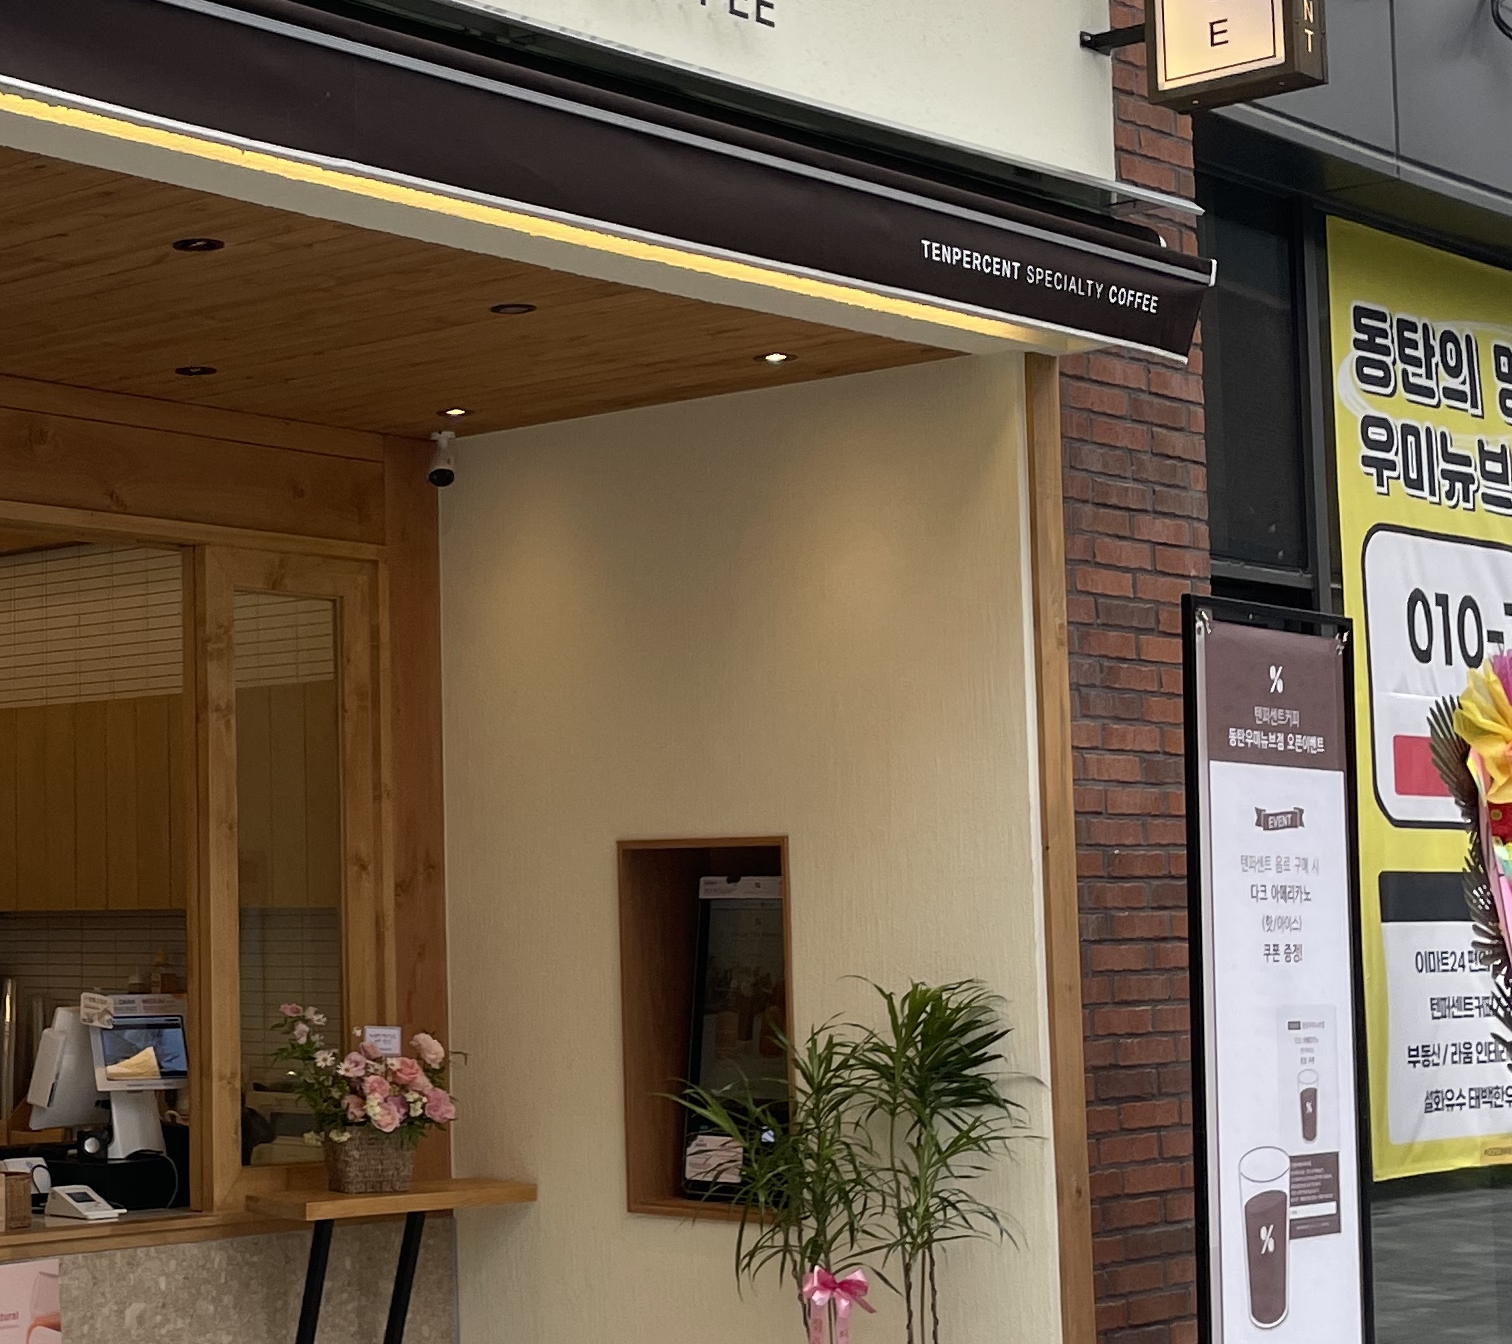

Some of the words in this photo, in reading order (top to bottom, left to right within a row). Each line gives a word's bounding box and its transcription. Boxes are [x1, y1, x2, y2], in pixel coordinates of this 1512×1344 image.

[921, 239, 1020, 280] TENPERCENT
[1026, 265, 1104, 299] SPECIALTY
[1109, 286, 1158, 314] COFFEE
[1352, 304, 1482, 416] 동탄의
[1407, 587, 1512, 668] 010-
[1268, 815, 1292, 828] EVENT
[1250, 884, 1268, 903] 다크
[1271, 885, 1311, 903] 아메리카노
[1263, 944, 1281, 963] 쿠폰
[1415, 950, 1466, 973] 이마트24
